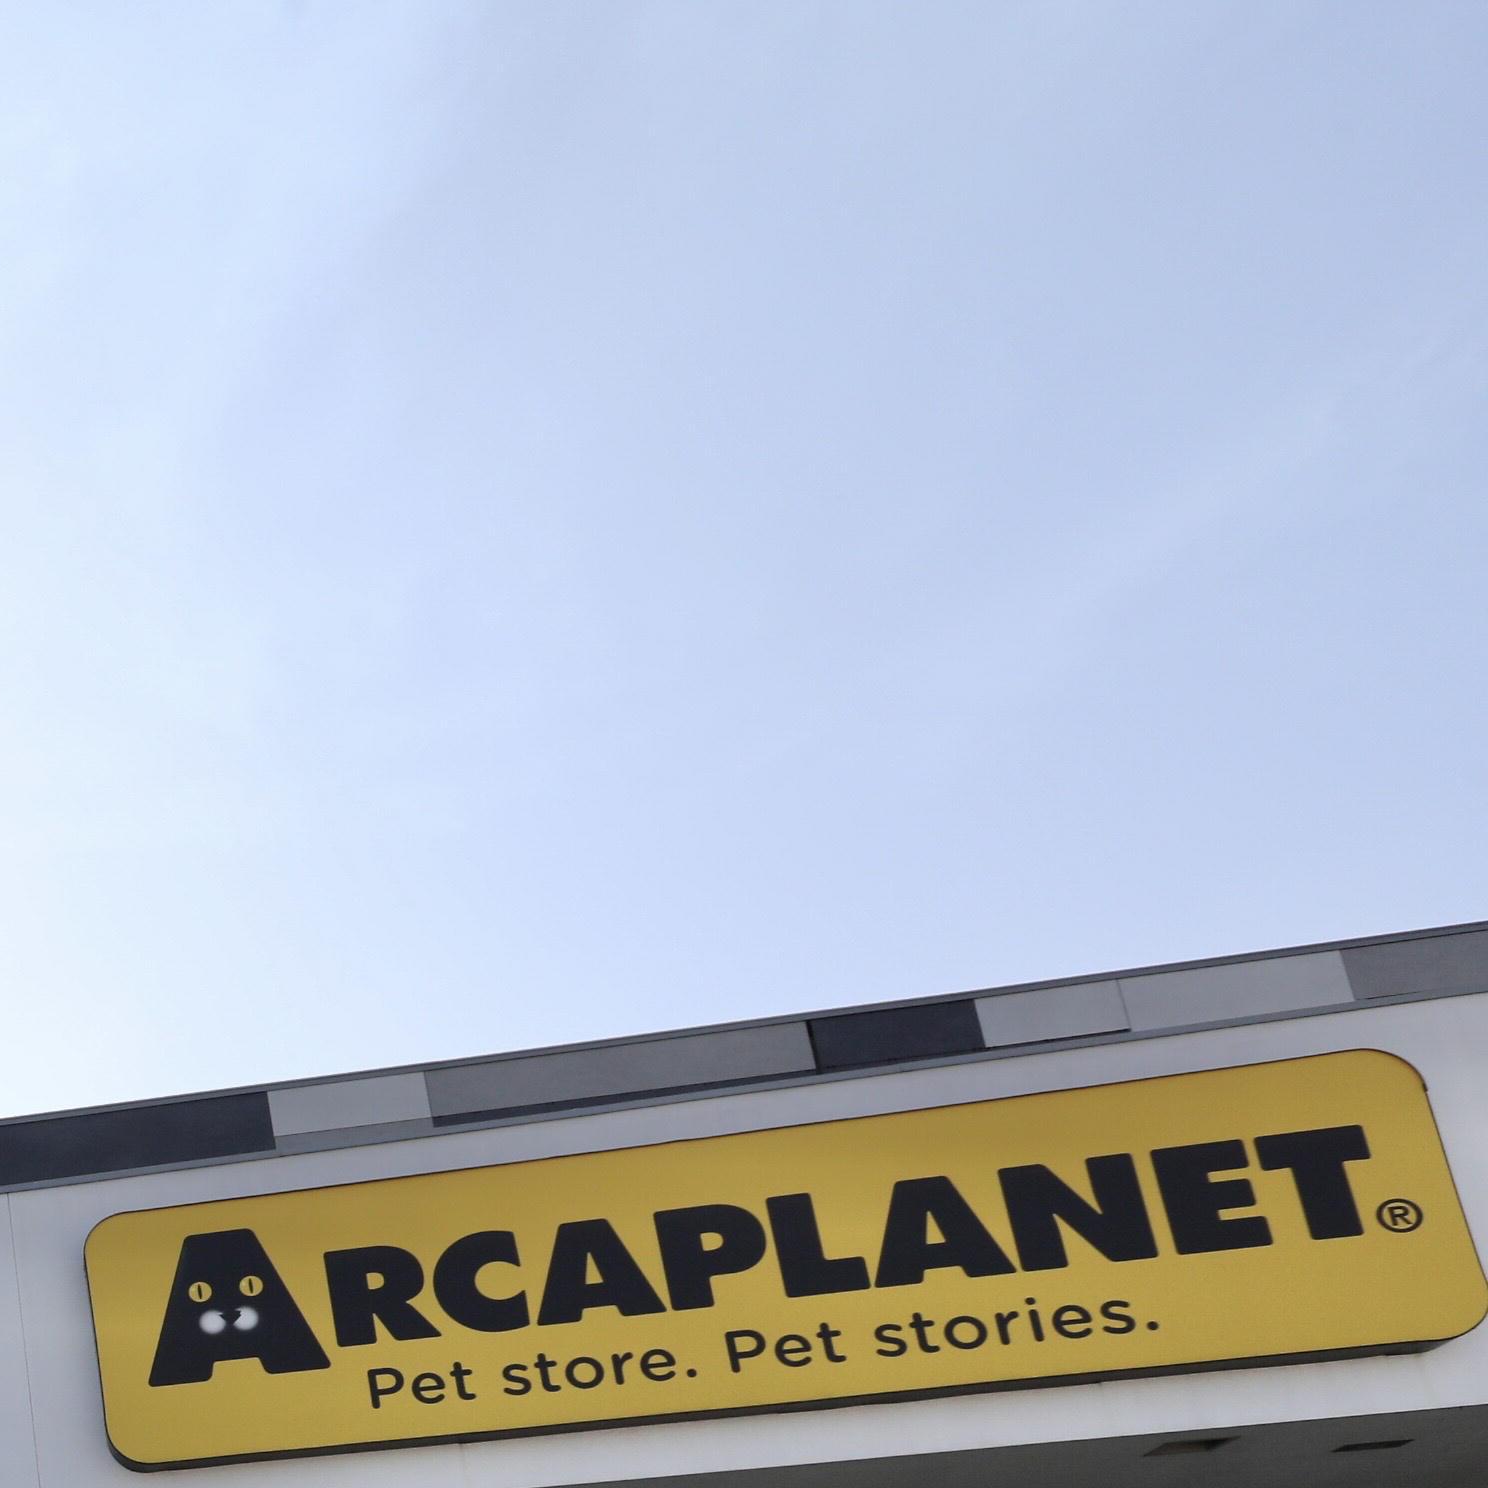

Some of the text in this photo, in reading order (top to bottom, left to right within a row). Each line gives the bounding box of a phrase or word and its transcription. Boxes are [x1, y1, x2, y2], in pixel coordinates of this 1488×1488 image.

[147, 1124, 1372, 1388] ARCAPLANET
[365, 1289, 1162, 1410] Pet store. Pet stories.
